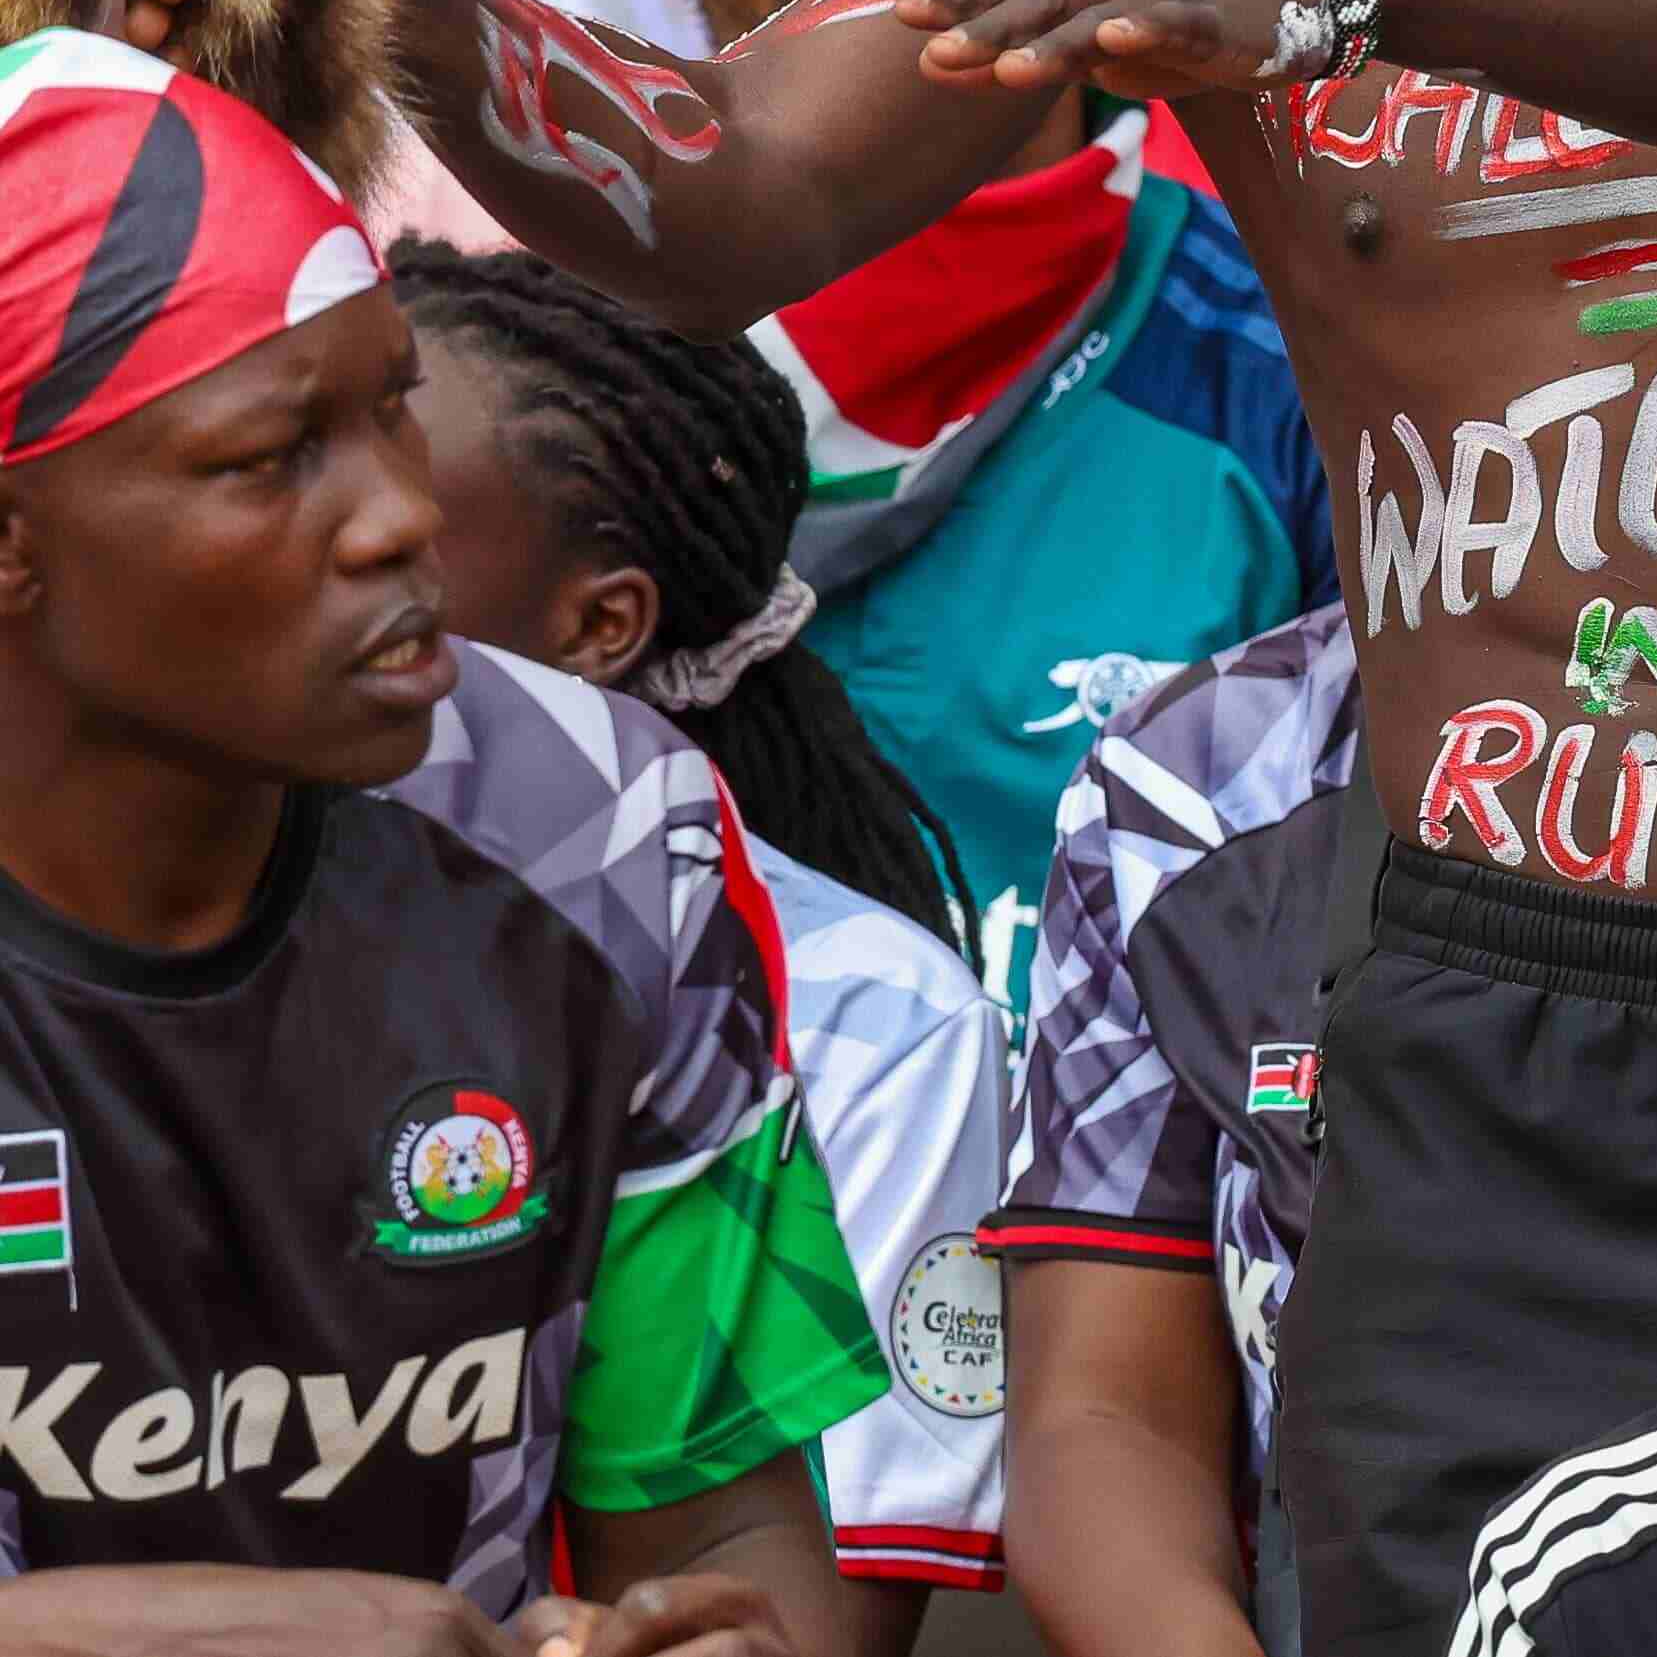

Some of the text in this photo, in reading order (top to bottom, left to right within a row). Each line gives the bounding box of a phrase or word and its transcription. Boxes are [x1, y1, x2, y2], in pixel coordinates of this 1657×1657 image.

[389, 1119, 426, 1223] FOOTBALL
[923, 1301, 1000, 1333] Celebra
[941, 1326, 998, 1347] Africa
[943, 1349, 994, 1367] CAF
[0, 1327, 527, 1502] Kenya
